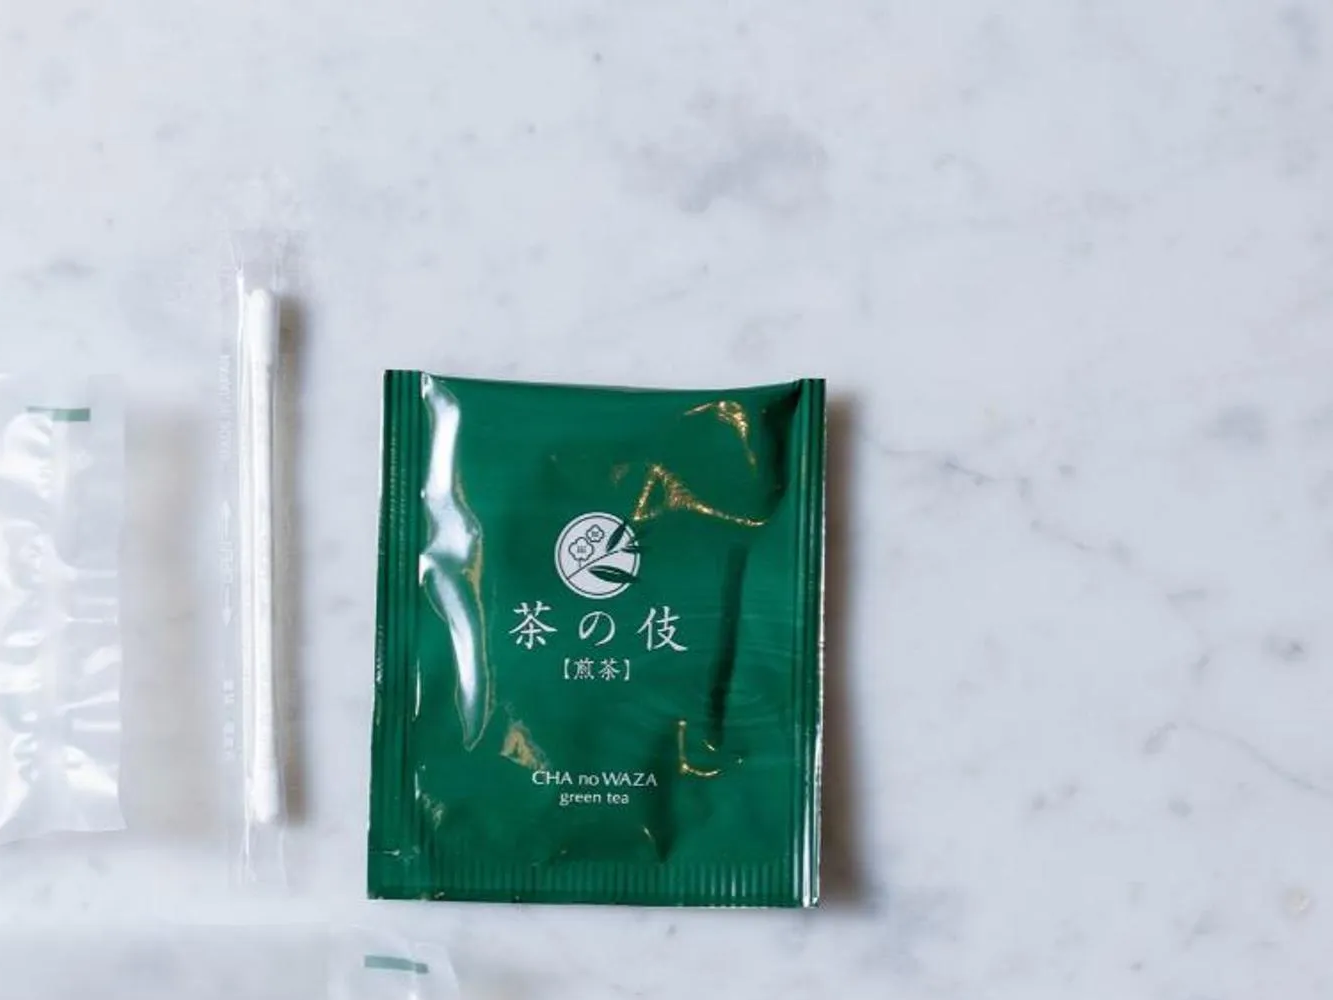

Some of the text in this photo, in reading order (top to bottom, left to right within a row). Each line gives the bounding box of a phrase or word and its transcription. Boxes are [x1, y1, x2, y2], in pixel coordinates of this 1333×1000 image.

[509, 601, 688, 651] 茶の伎
[532, 769, 658, 787] CHA no WAZA
[559, 791, 630, 806] green tea
